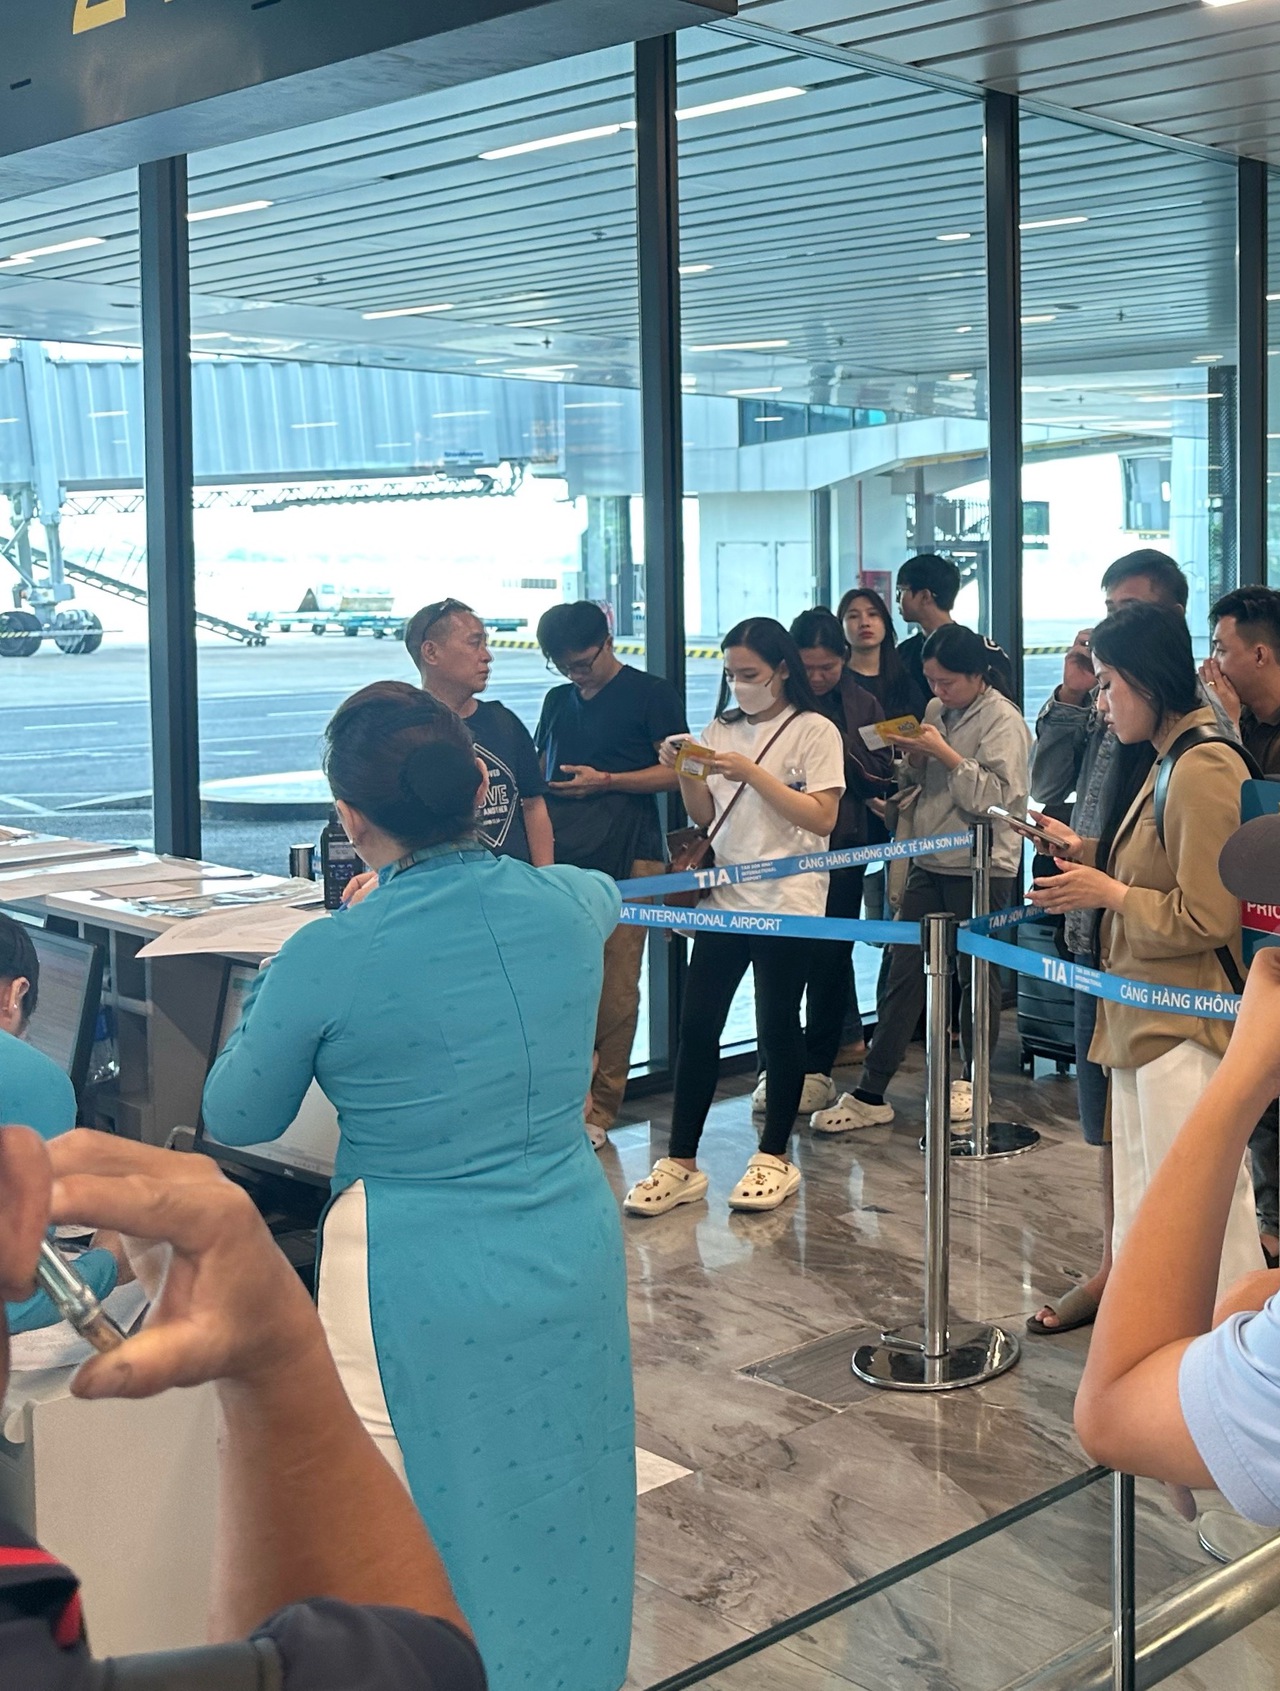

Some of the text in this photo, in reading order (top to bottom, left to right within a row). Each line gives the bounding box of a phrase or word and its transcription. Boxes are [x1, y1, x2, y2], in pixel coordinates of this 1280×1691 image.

[483, 805, 508, 816] ANOTHER
[826, 852, 851, 867] HÀNG
[853, 847, 882, 862] KHÔNG
[884, 841, 906, 857] QUỐC
[694, 868, 731, 888] TIA
[640, 910, 728, 928] INTERNATIONAL
[730, 916, 782, 931] AIRPORT
[989, 914, 1007, 929] TAN
[1042, 957, 1067, 985] TIA
[1152, 988, 1191, 1009] HÀNG
